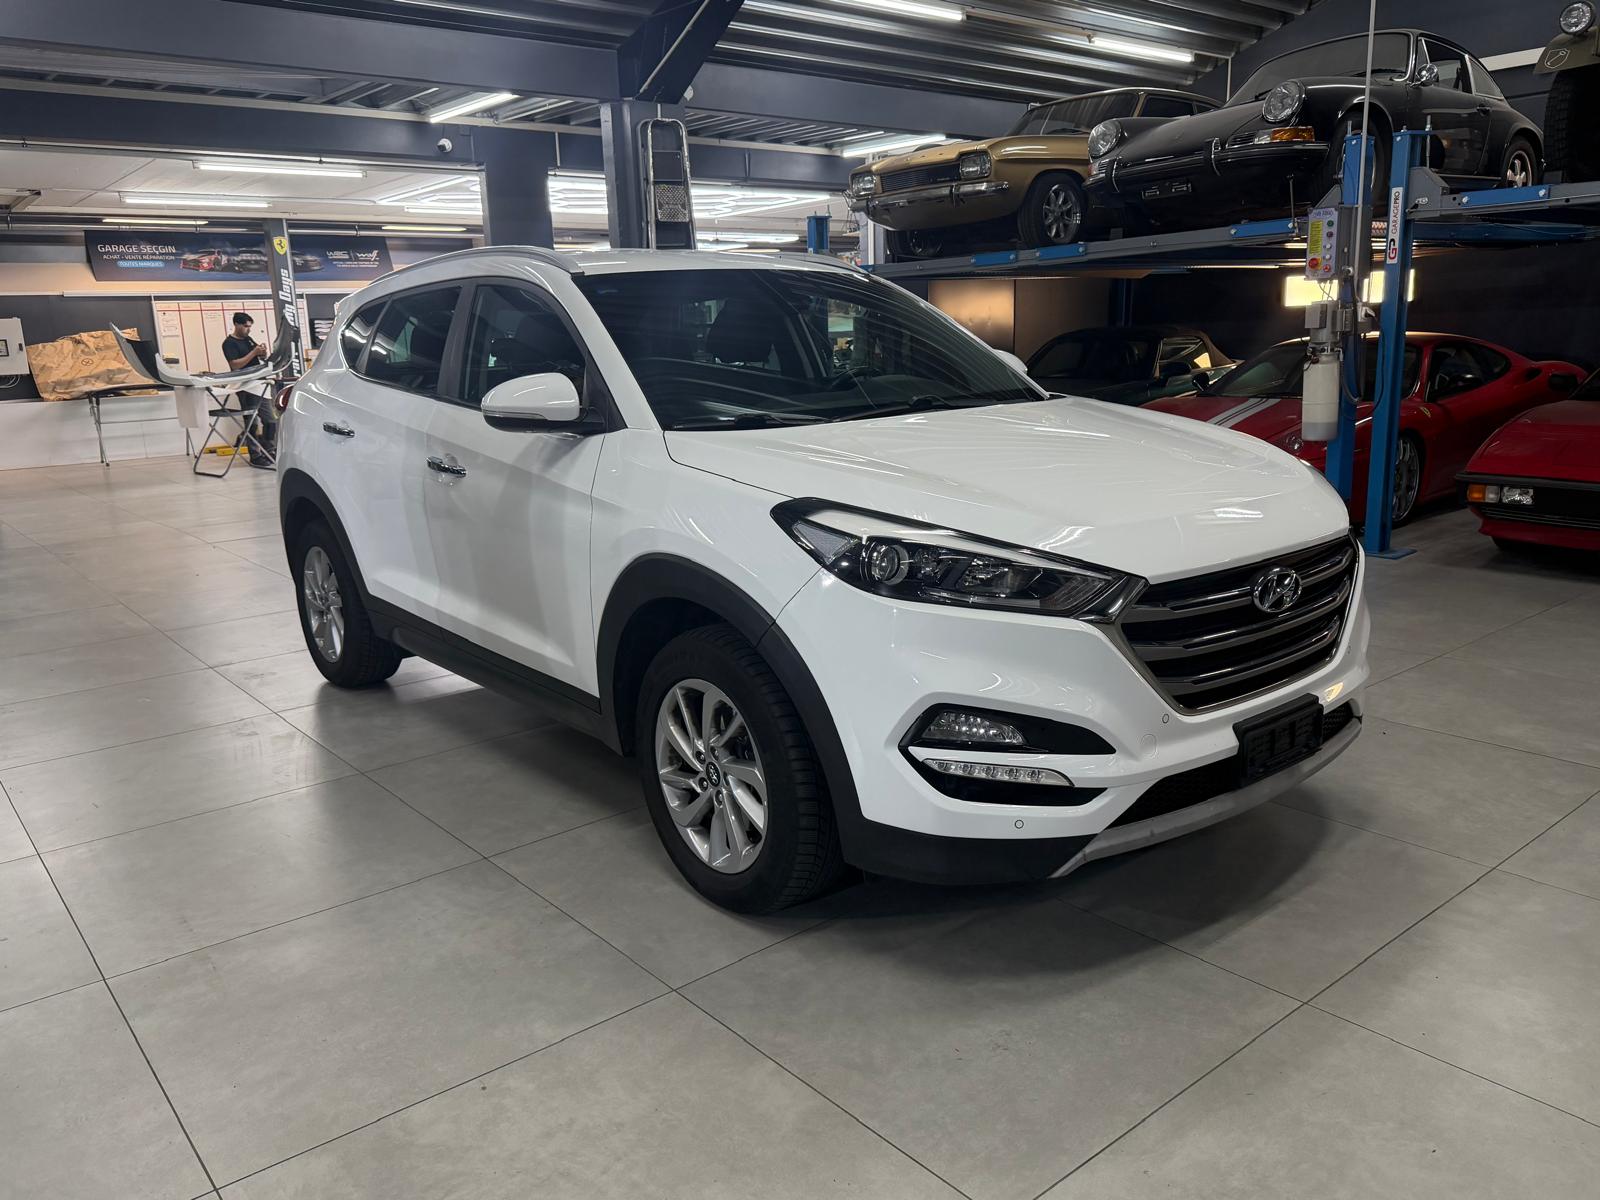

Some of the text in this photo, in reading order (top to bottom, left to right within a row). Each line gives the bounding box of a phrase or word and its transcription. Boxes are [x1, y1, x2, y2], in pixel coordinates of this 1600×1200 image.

[1391, 190, 1400, 235] GARAGEPRO
[97, 244, 176, 254] GARAGE SEÇGIN
[279, 268, 293, 302] Days
